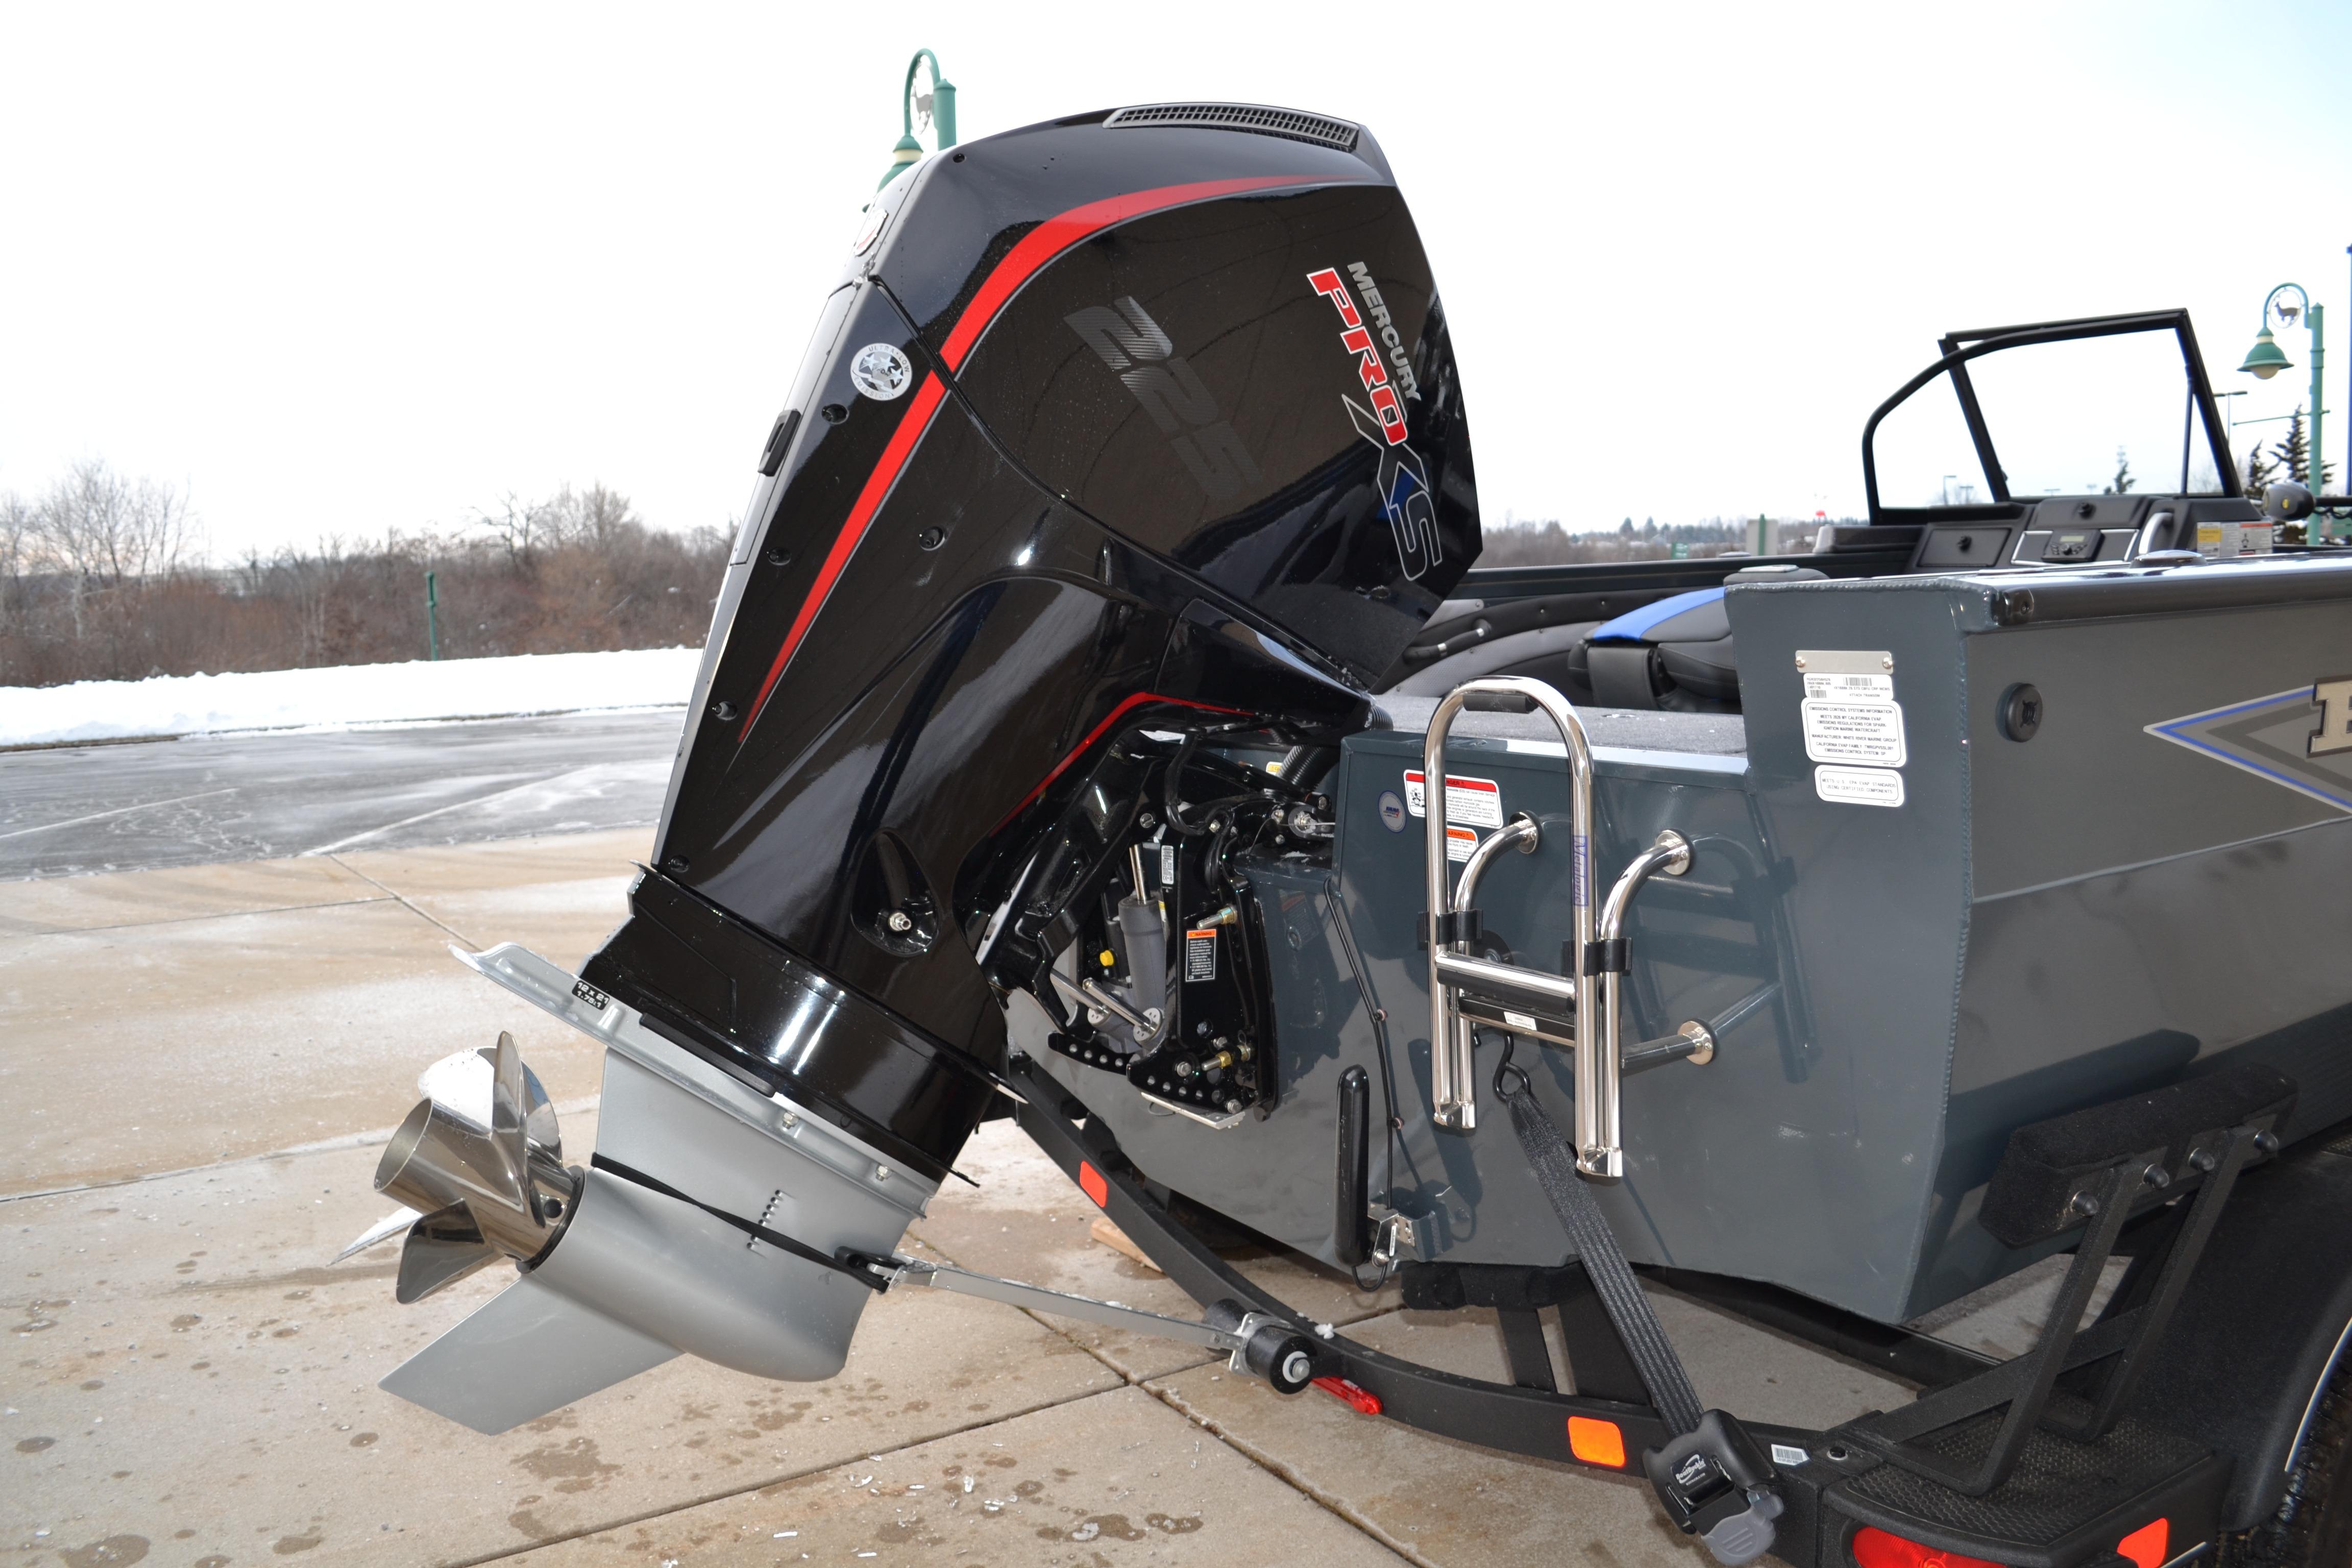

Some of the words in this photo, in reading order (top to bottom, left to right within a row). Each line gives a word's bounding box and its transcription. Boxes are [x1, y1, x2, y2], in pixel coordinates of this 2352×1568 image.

[1307, 267, 1408, 446] PRO
[1347, 261, 1422, 401] MERCURY
[899, 355, 910, 372] LOW
[1063, 296, 1263, 499] 225
[1574, 840, 1585, 903] Metalogic
[577, 991, 601, 1008] 1.75:1
[578, 982, 589, 993] 12
[596, 993, 609, 1004] 21
